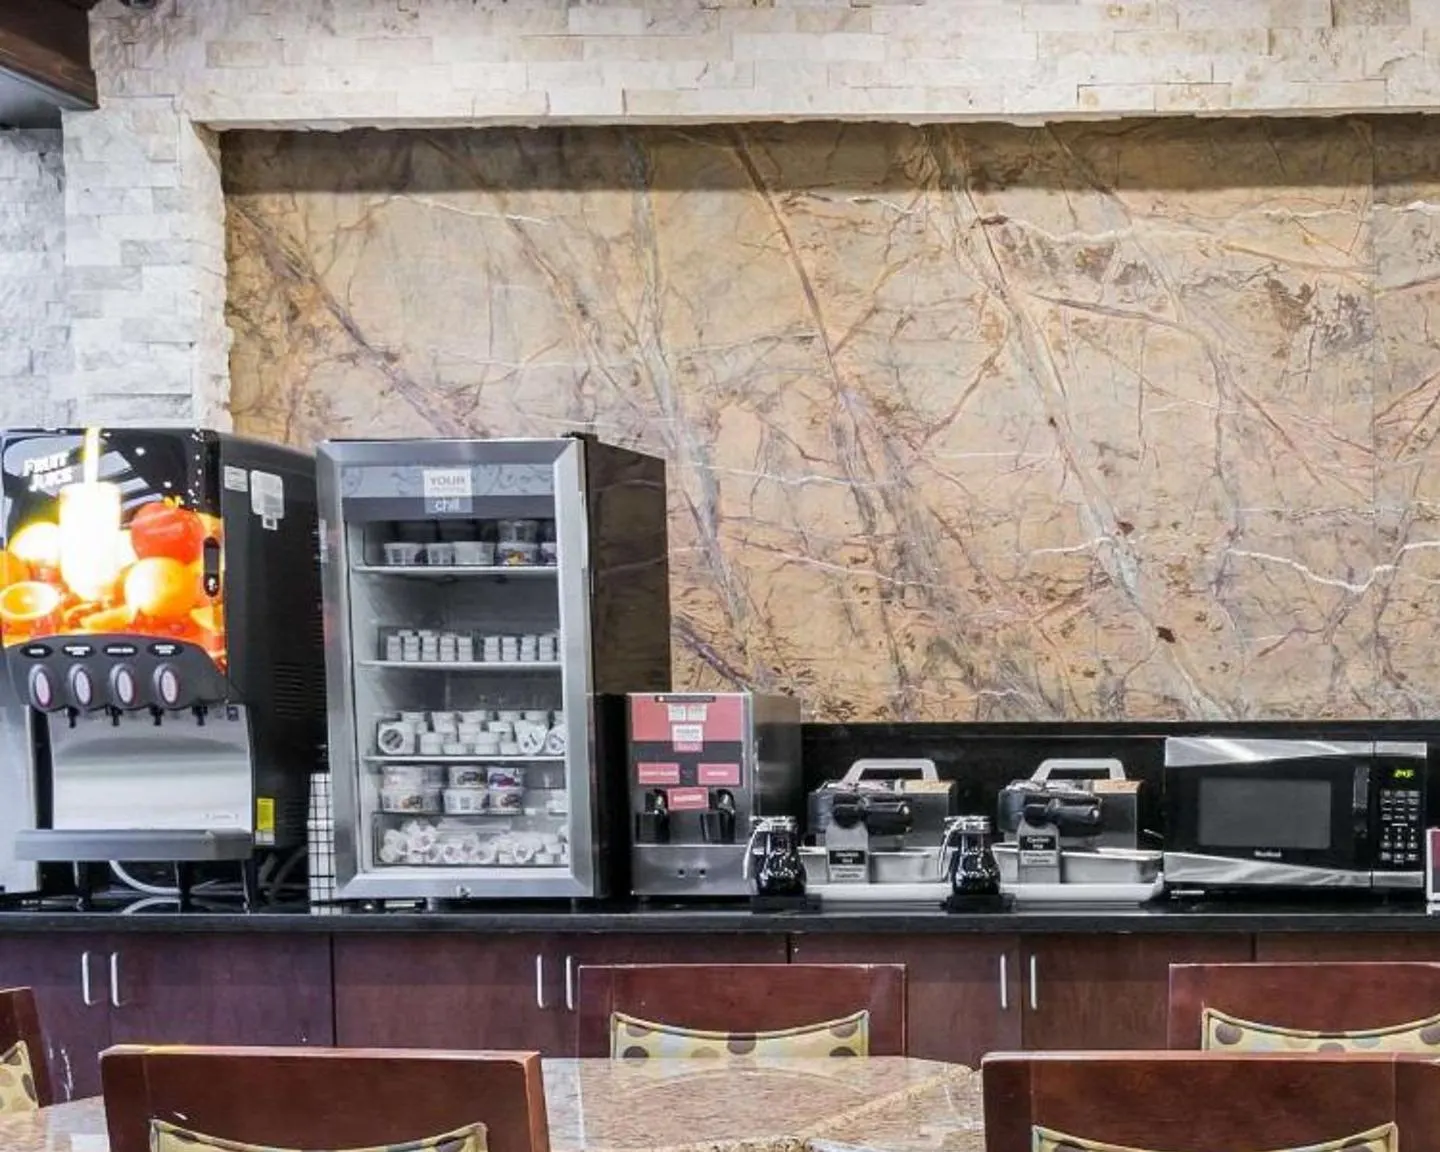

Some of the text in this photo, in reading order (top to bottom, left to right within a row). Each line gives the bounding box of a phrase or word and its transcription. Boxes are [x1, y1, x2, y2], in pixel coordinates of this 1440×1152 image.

[23, 452, 69, 477] FRUIT
[29, 467, 73, 492] JUICE
[429, 475, 466, 486] YOUR
